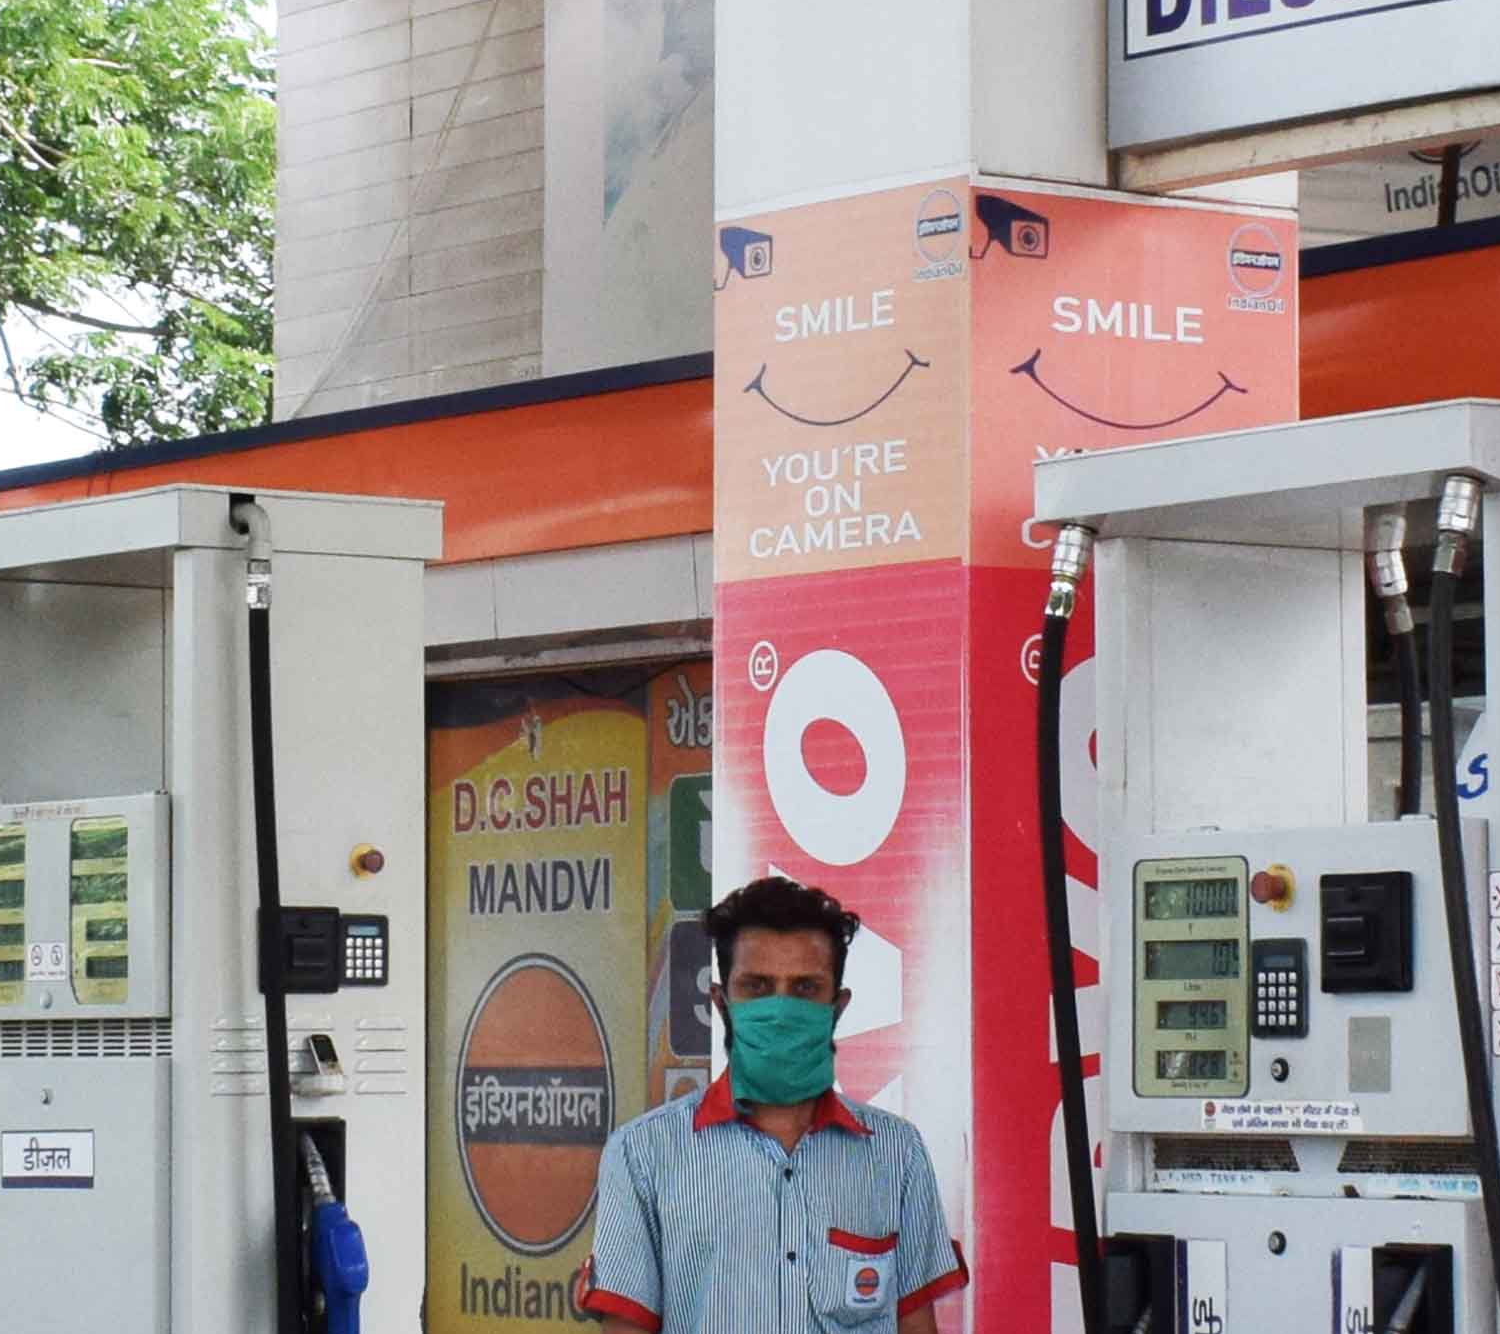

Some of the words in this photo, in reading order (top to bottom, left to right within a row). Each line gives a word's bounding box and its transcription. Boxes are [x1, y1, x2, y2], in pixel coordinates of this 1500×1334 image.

[774, 289, 895, 344] SMILE
[1051, 296, 1205, 345] SMILE
[761, 441, 908, 488] YOU'RE
[804, 481, 863, 517] ON
[748, 512, 923, 559] CAMERA
[468, 858, 612, 915] MANDVI
[464, 1074, 604, 1135] इंडियनऑयल
[460, 1262, 588, 1322] Indian
